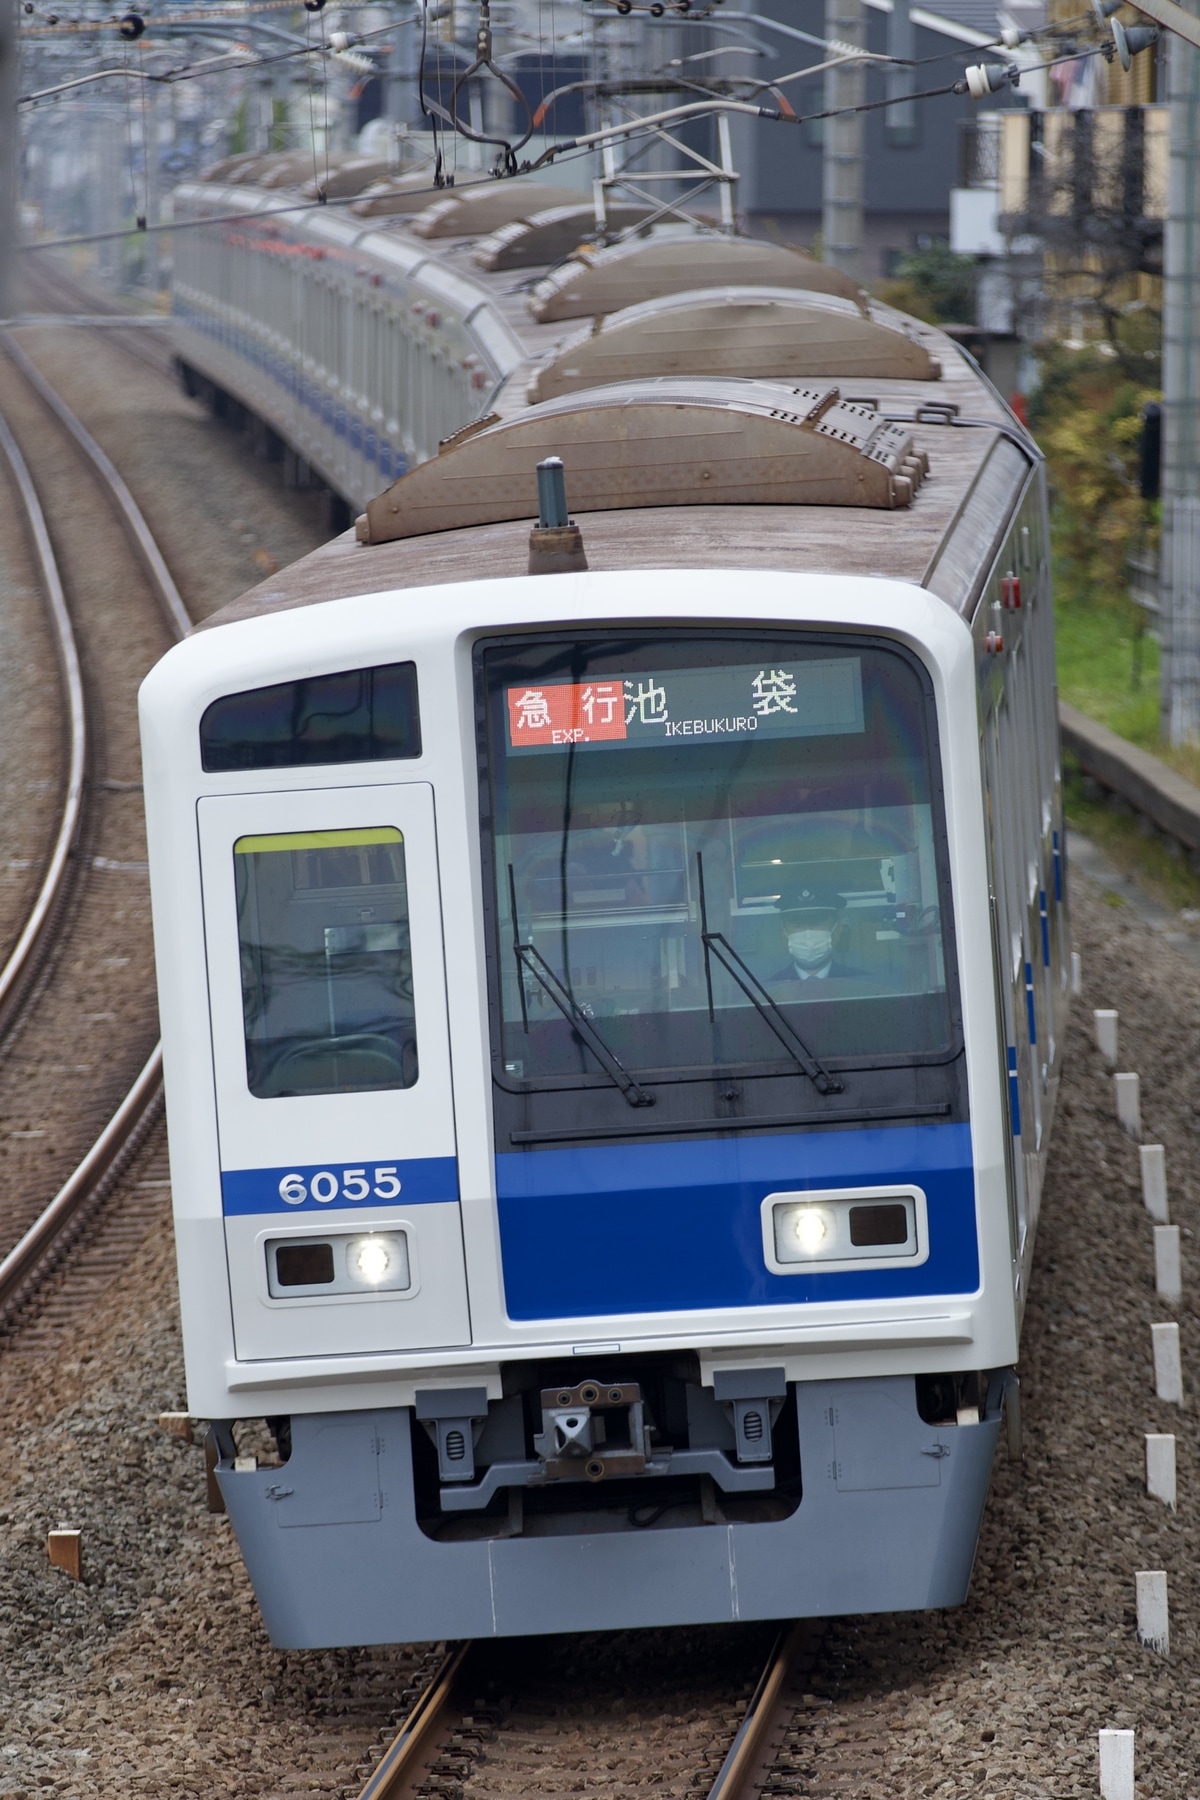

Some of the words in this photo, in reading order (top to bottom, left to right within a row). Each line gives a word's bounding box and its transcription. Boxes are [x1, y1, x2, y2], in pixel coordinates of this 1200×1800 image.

[551, 728, 590, 745] EXP.
[665, 716, 758, 737] IKEBUKURO
[279, 1167, 402, 1205] 6055
